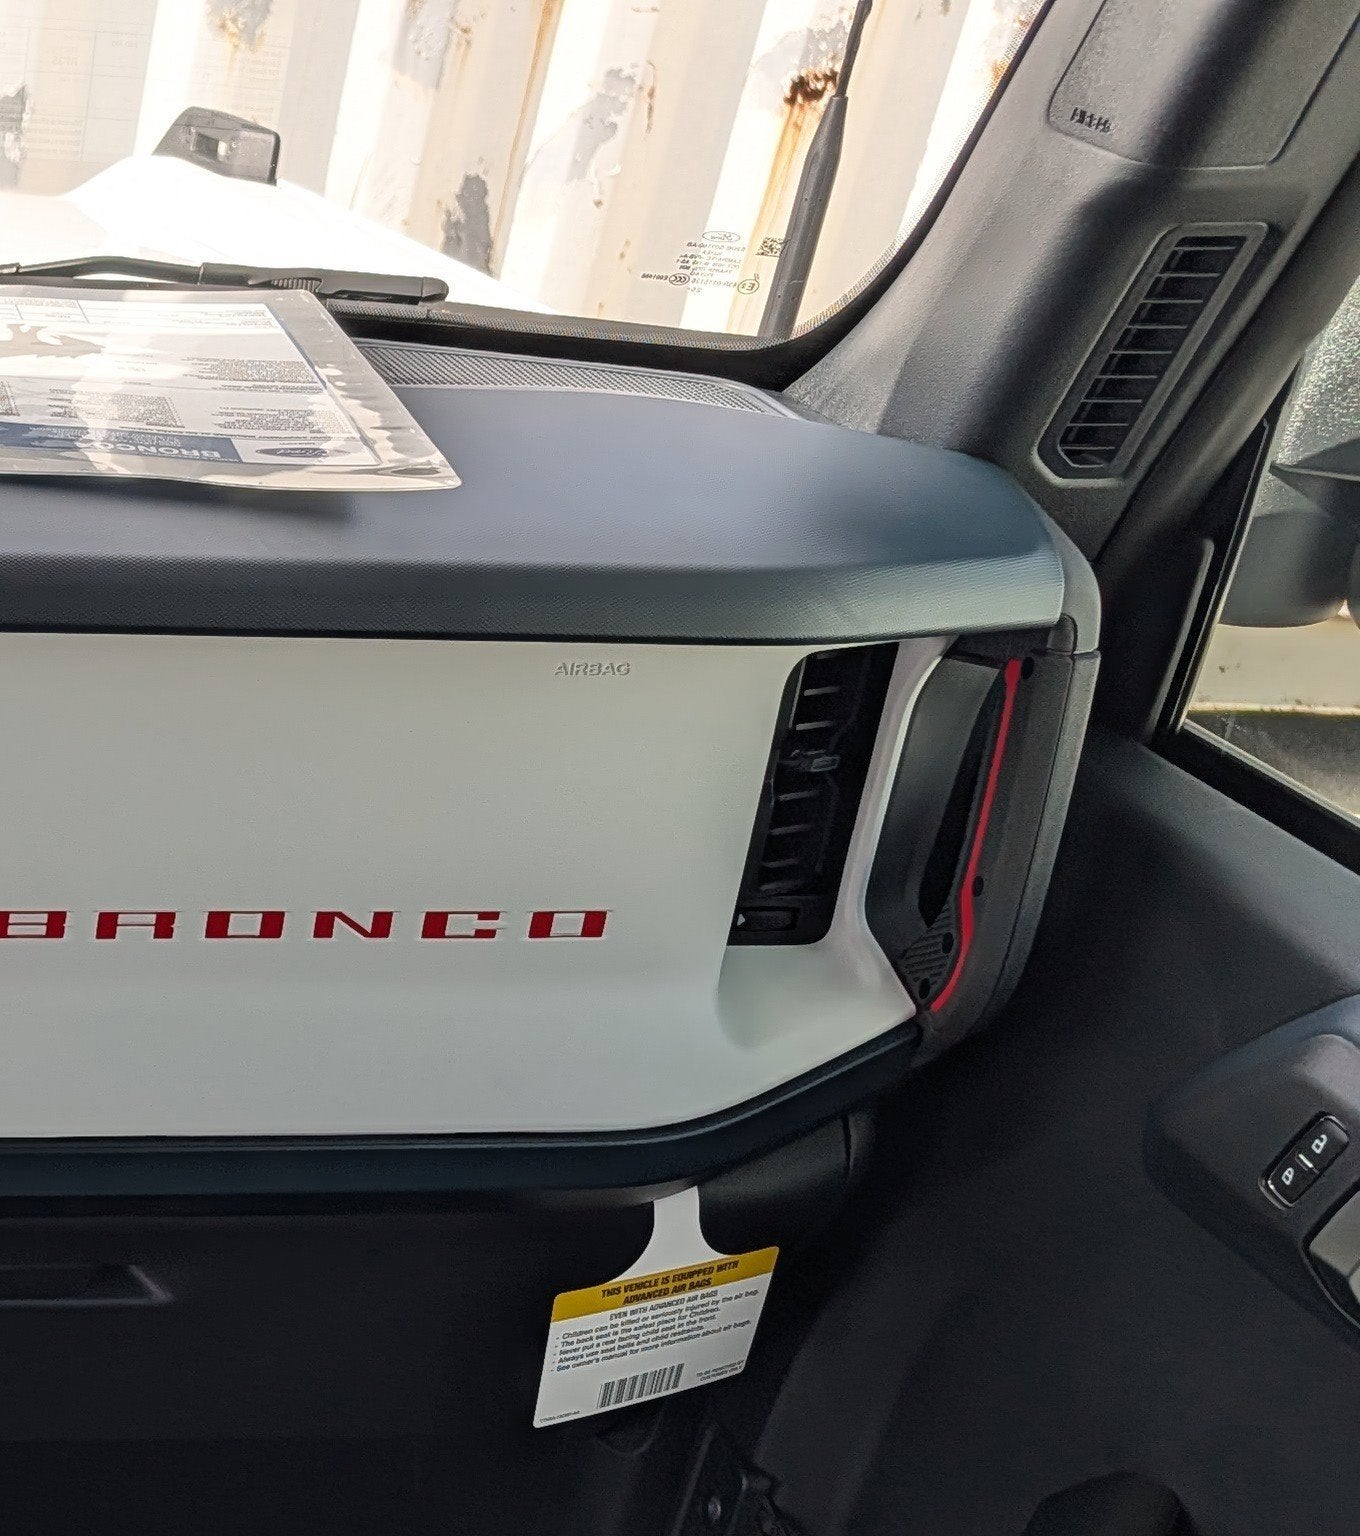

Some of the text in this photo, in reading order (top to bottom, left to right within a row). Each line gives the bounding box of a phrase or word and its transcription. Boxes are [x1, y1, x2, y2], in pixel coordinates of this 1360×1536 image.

[554, 662, 631, 676] AIRBAG
[622, 1278, 712, 1305] ADVANCED AIR BAGS
[623, 1278, 660, 1293] VEHICLE
